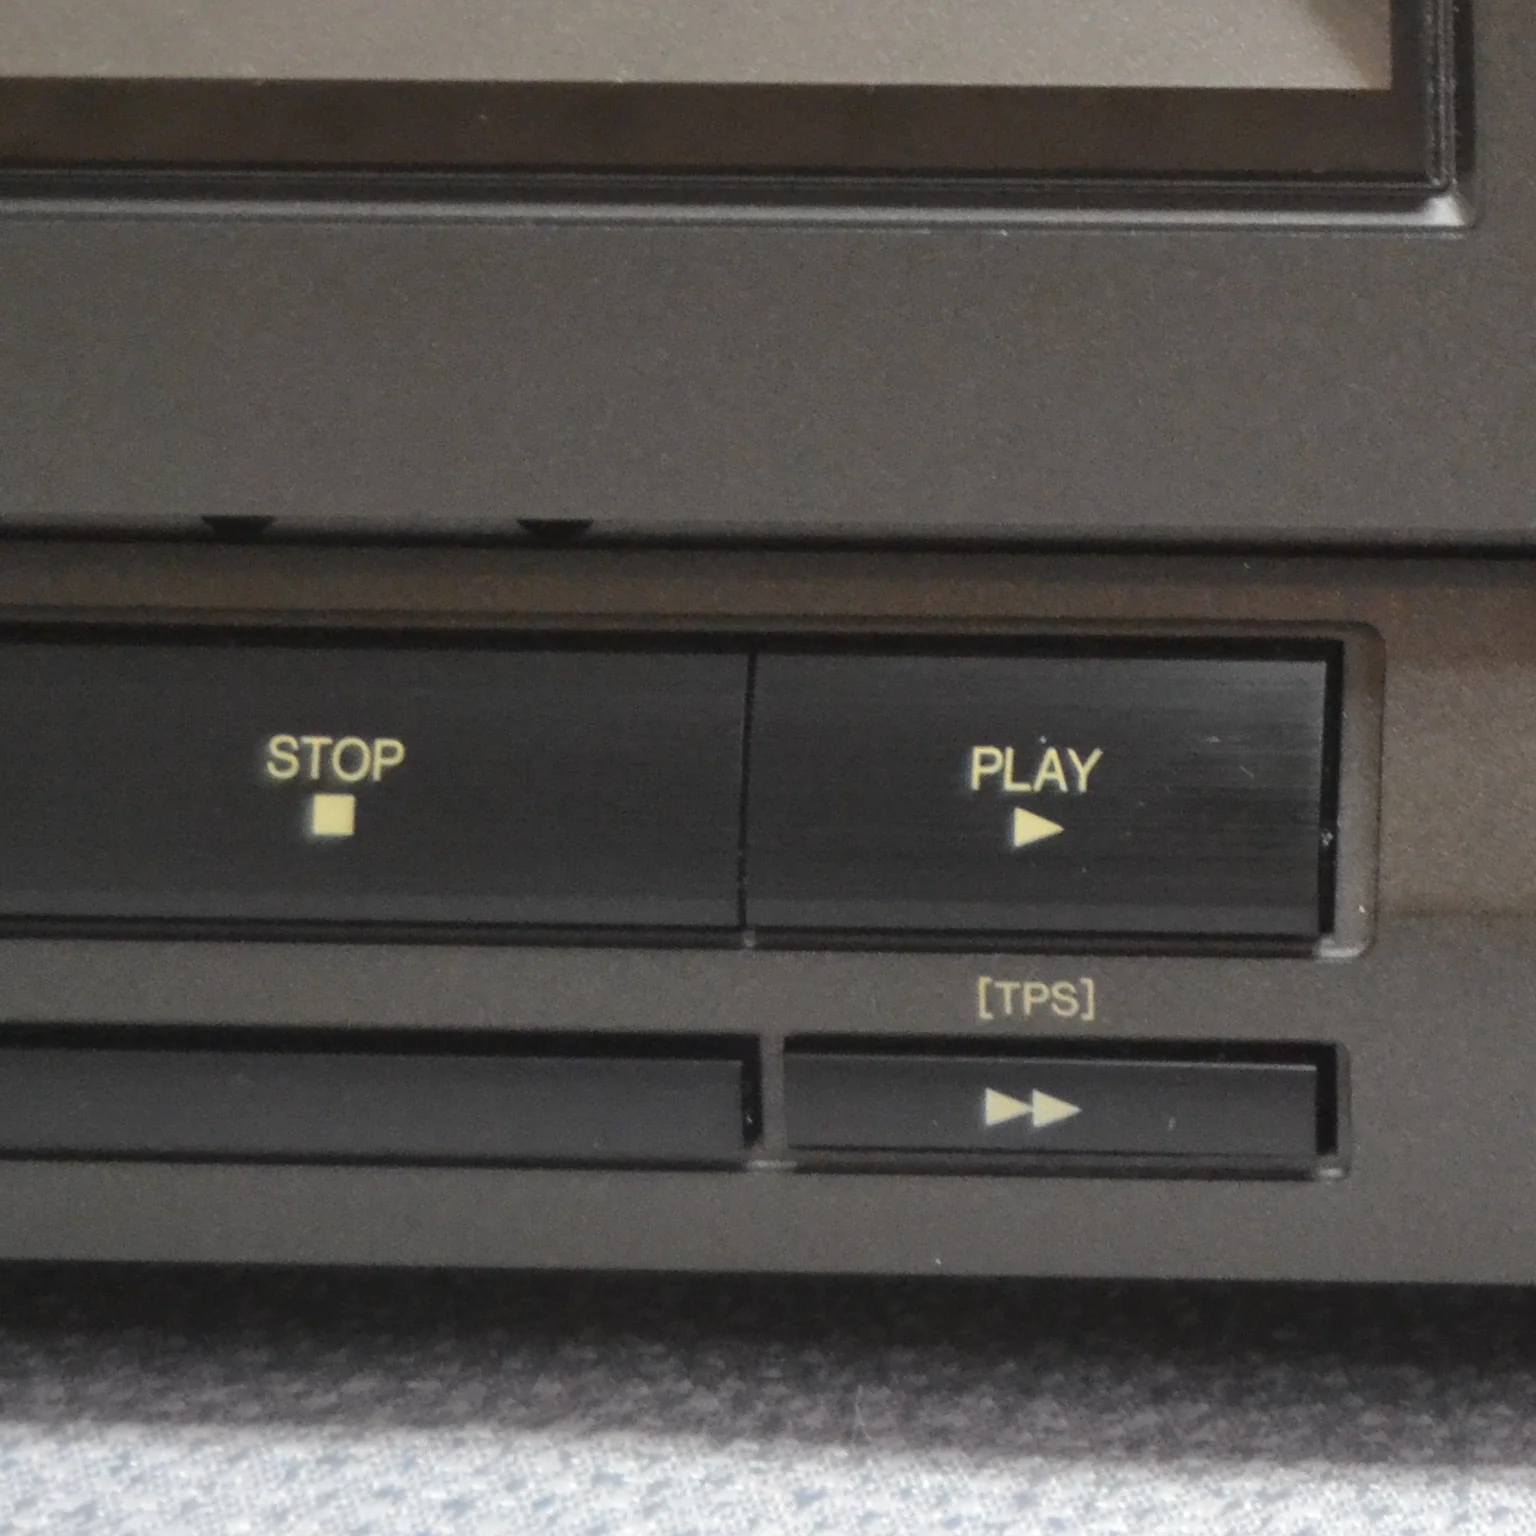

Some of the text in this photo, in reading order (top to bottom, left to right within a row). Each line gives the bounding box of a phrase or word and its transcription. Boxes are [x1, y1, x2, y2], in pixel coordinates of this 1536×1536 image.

[265, 733, 406, 783] STOP
[969, 745, 1103, 793] PLAY
[976, 975, 1096, 1022] [TPS]
